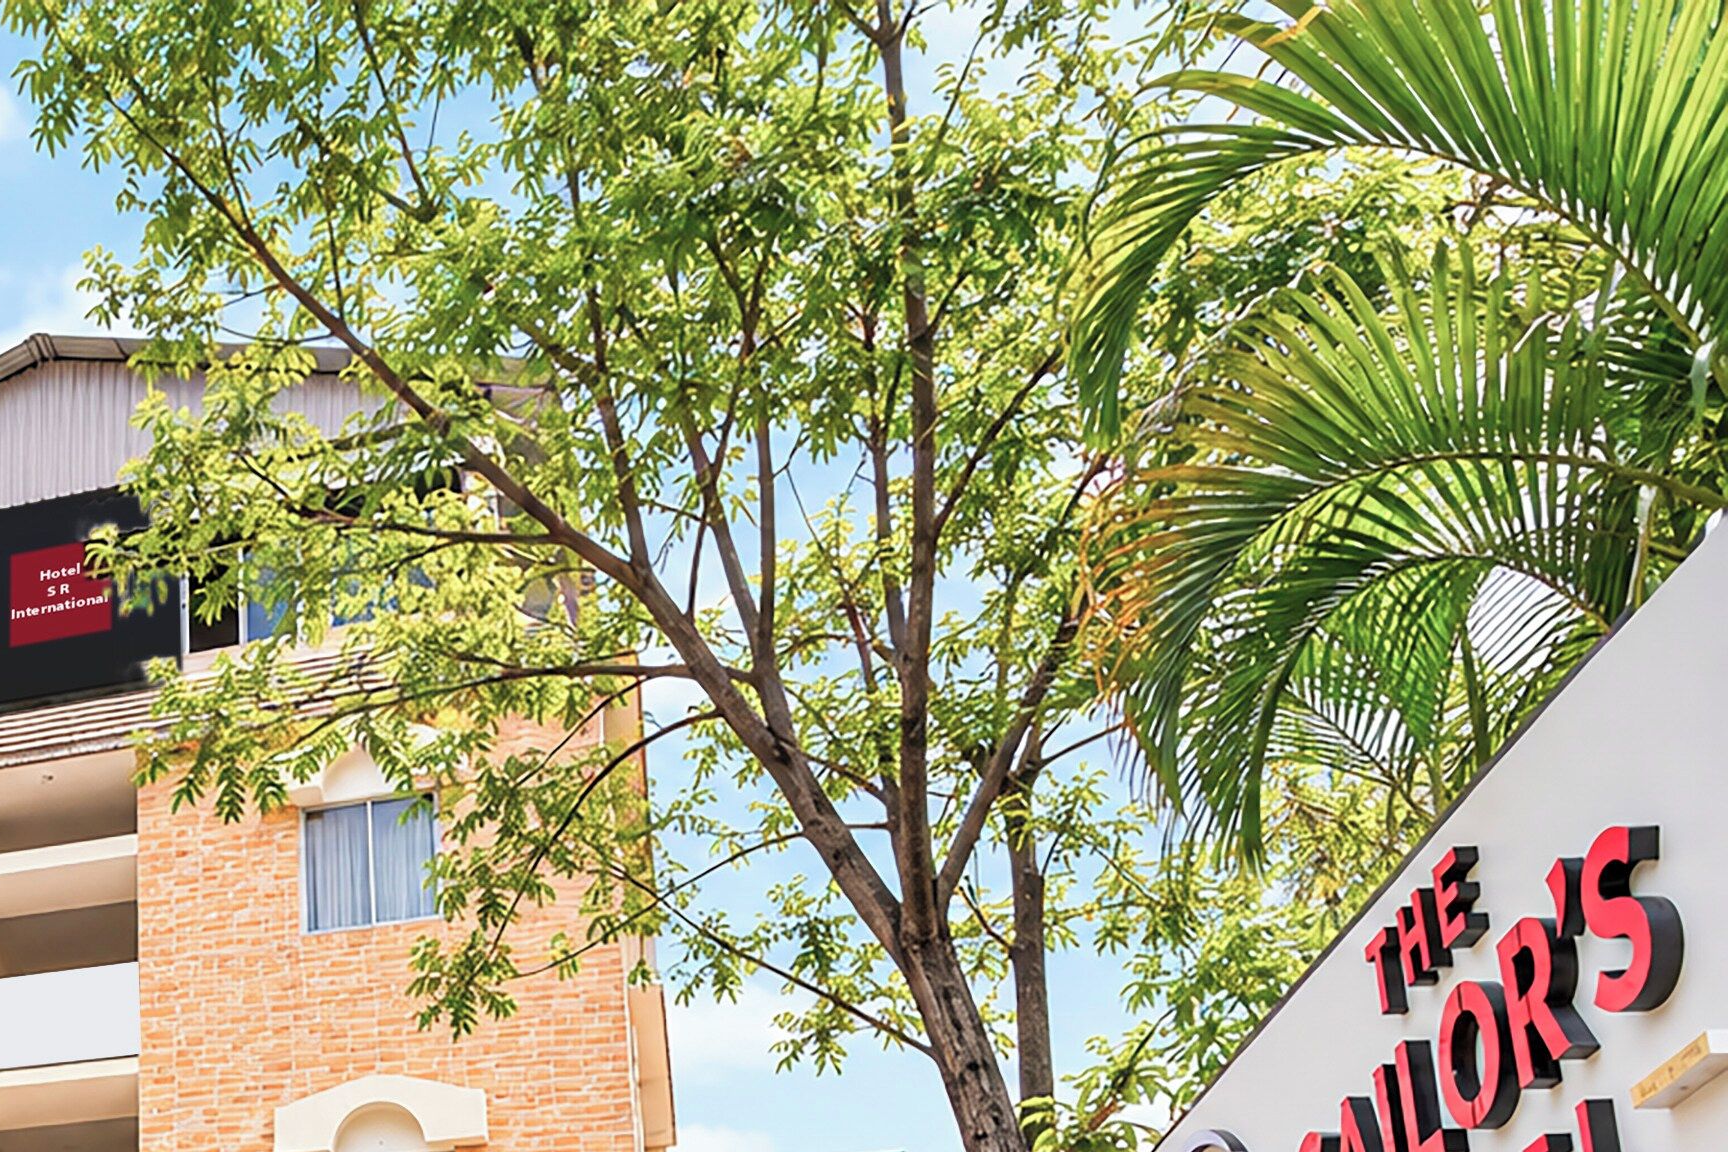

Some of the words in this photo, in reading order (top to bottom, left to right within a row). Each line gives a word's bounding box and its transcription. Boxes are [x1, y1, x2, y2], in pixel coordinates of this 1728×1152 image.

[39, 562, 81, 581] Hotel
[47, 585, 57, 597] S
[59, 583, 70, 595] R
[11, 593, 109, 620] International
[1364, 845, 1490, 1015] THE
